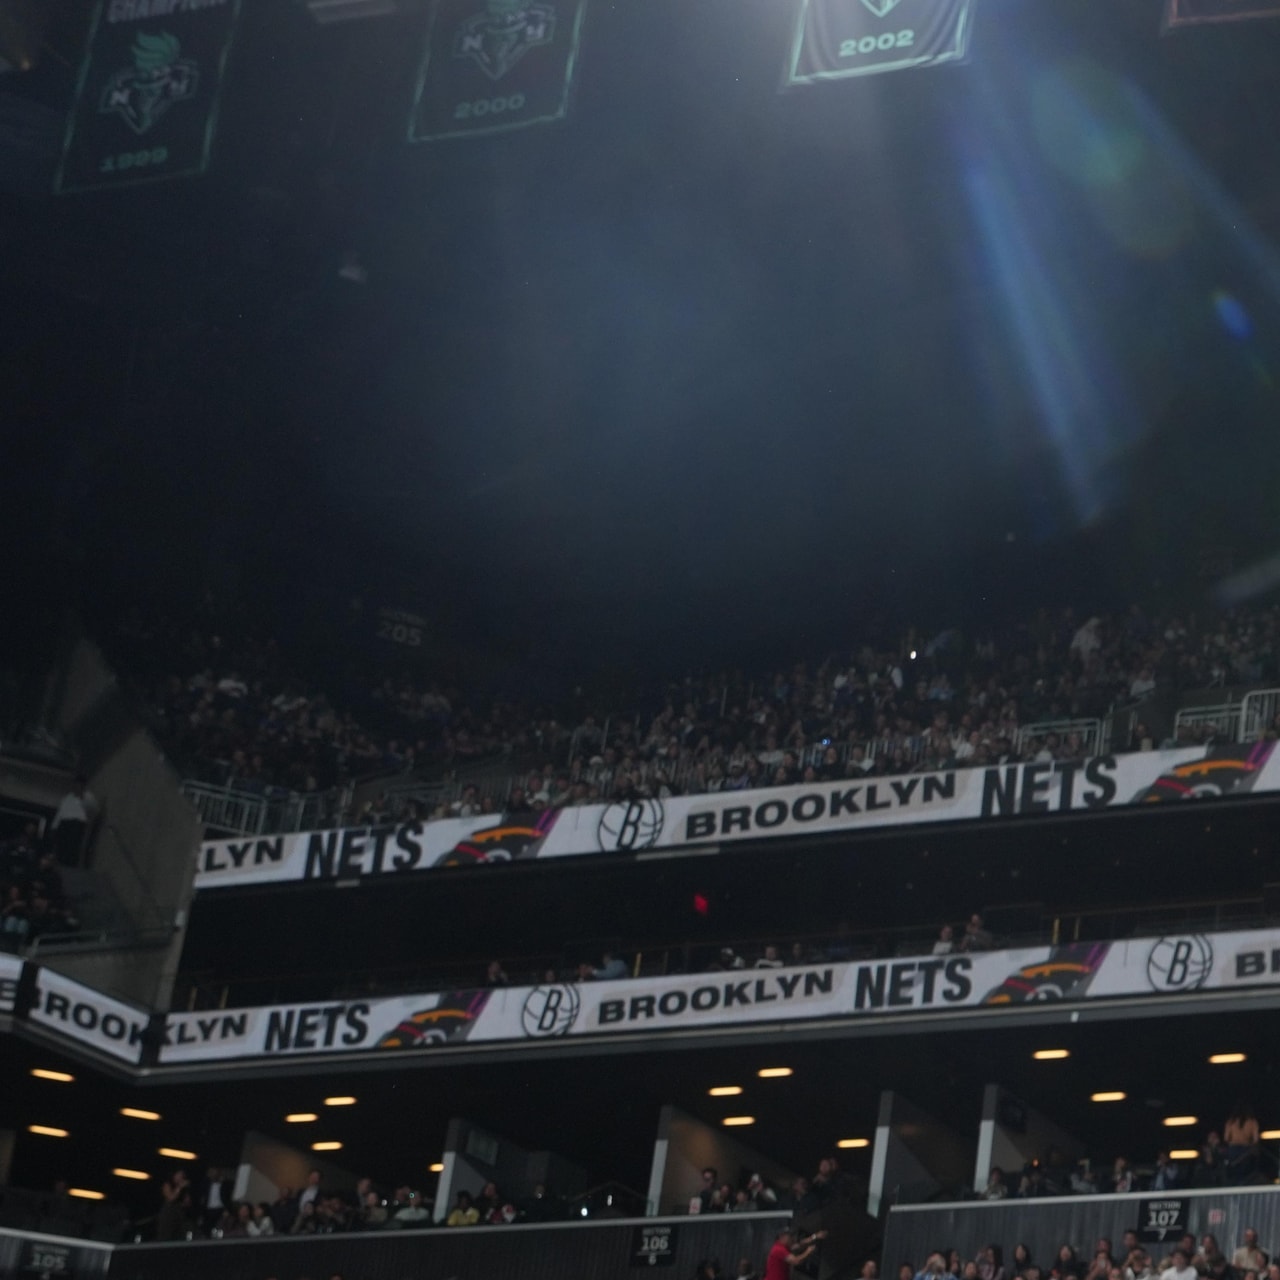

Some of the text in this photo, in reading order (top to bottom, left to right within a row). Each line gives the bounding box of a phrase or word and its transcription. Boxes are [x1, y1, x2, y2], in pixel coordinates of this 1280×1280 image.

[839, 29, 915, 56] 2002
[685, 757, 1118, 841] BROOKLYN NETS
[199, 825, 424, 880] LYN NETS
[597, 958, 973, 1025] BROOKLYN NETS
[264, 1002, 368, 1052] NETS
[641, 1236, 670, 1252] 106
[1149, 1211, 1180, 1227] 107
